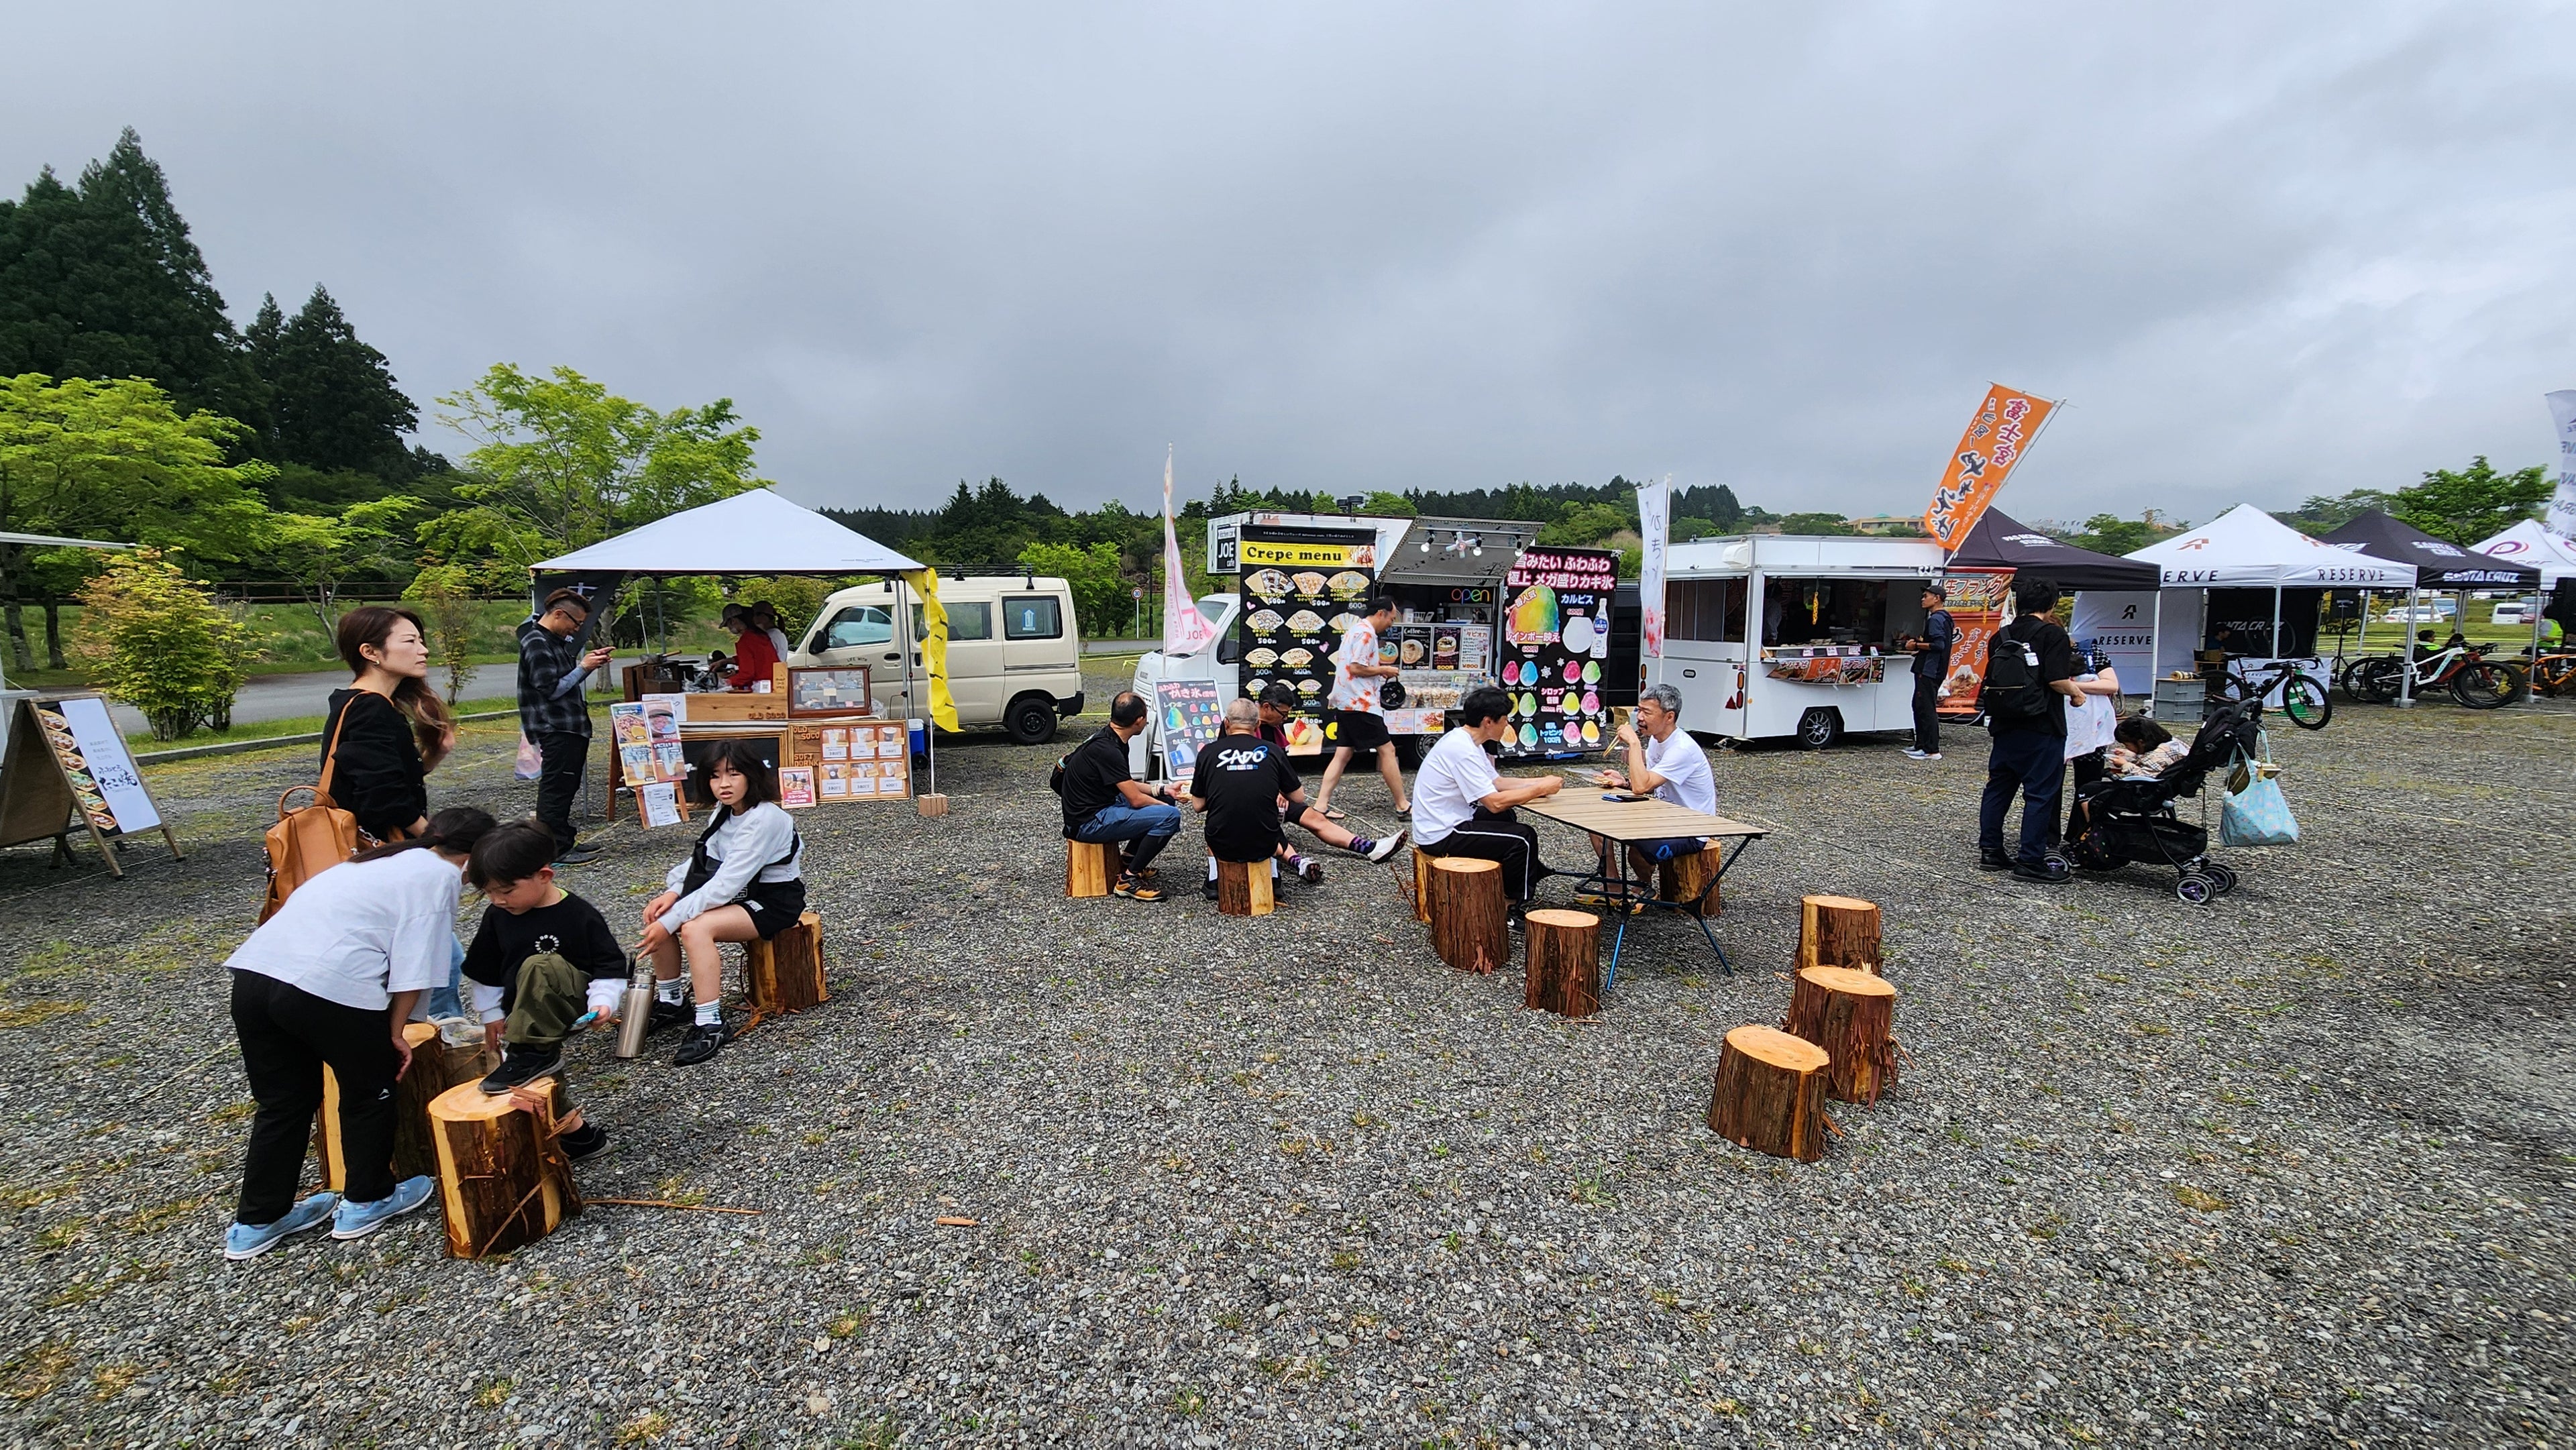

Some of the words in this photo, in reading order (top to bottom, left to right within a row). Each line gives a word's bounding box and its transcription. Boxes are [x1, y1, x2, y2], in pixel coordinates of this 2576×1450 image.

[1992, 398, 2031, 467] 富士宮
[1218, 541, 1234, 558] JOE
[2412, 541, 2457, 551] SANTA
[1246, 547, 1293, 561] Crepe
[1299, 550, 1342, 561] menu
[1515, 553, 1562, 569] 雪みたい
[1564, 556, 1611, 572] ふわふわ
[1508, 571, 1532, 585] 極上
[1534, 572, 1615, 590] メガ盛りカキ氷
[2163, 570, 2219, 582] ERVE
[2318, 568, 2385, 581] RESERVE
[2443, 570, 2484, 581] SANTA
[2485, 571, 2520, 583] CRUZ
[1945, 578, 2003, 596] 生フランク
[1452, 589, 1490, 604] open
[1561, 594, 1594, 604] カルピス
[1951, 627, 1981, 666] 富士宮
[2099, 635, 2152, 645] RESERVE
[1169, 688, 1202, 698] かき氷
[1541, 687, 1565, 695] シロップ
[1216, 748, 1264, 768] SADO
